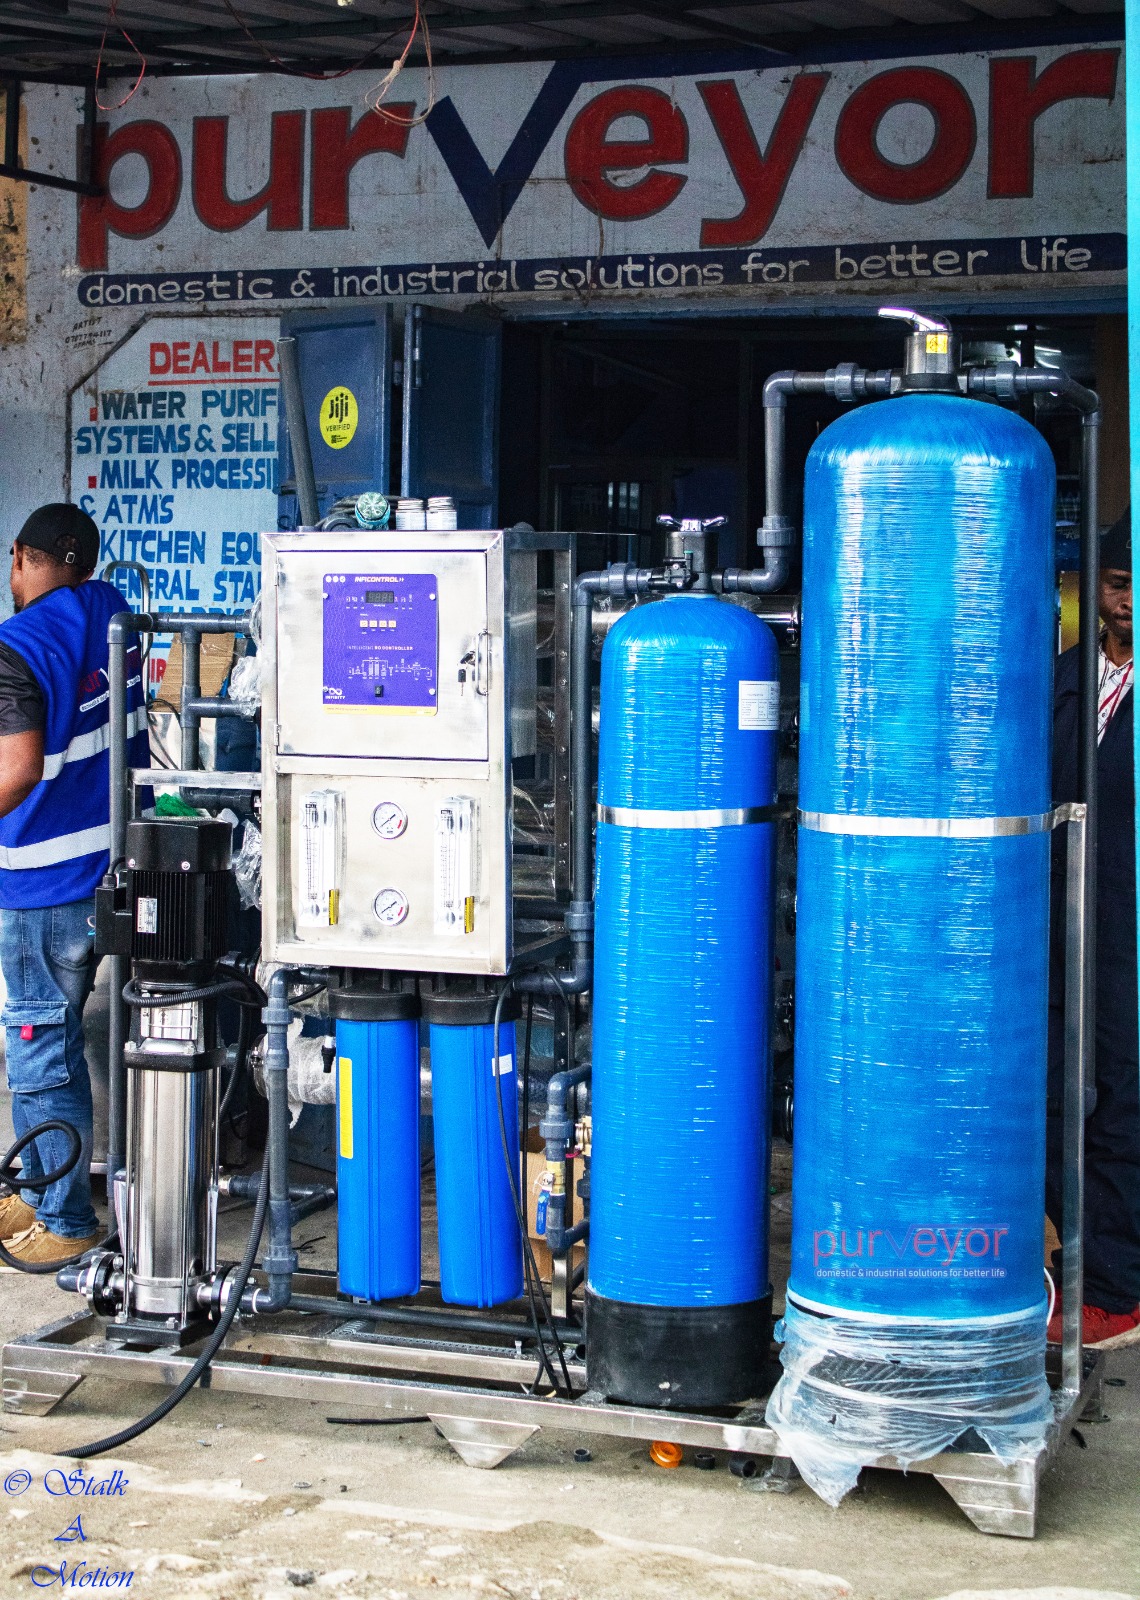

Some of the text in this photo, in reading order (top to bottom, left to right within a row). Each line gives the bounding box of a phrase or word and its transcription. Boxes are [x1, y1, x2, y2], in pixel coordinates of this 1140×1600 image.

[86, 272, 274, 305] domestic
[290, 269, 315, 298] &
[332, 260, 520, 296] industrial
[534, 256, 724, 290] solutions
[741, 252, 810, 283] for
[835, 244, 989, 280] better
[149, 340, 281, 374] DEALER
[101, 391, 186, 420] WATER
[75, 424, 191, 455] SYSTEMS
[195, 423, 216, 453] &
[325, 423, 351, 432] VERIFIED
[100, 459, 163, 489] MILK
[100, 530, 207, 564] KITCHEN
[213, 570, 262, 604] STA
